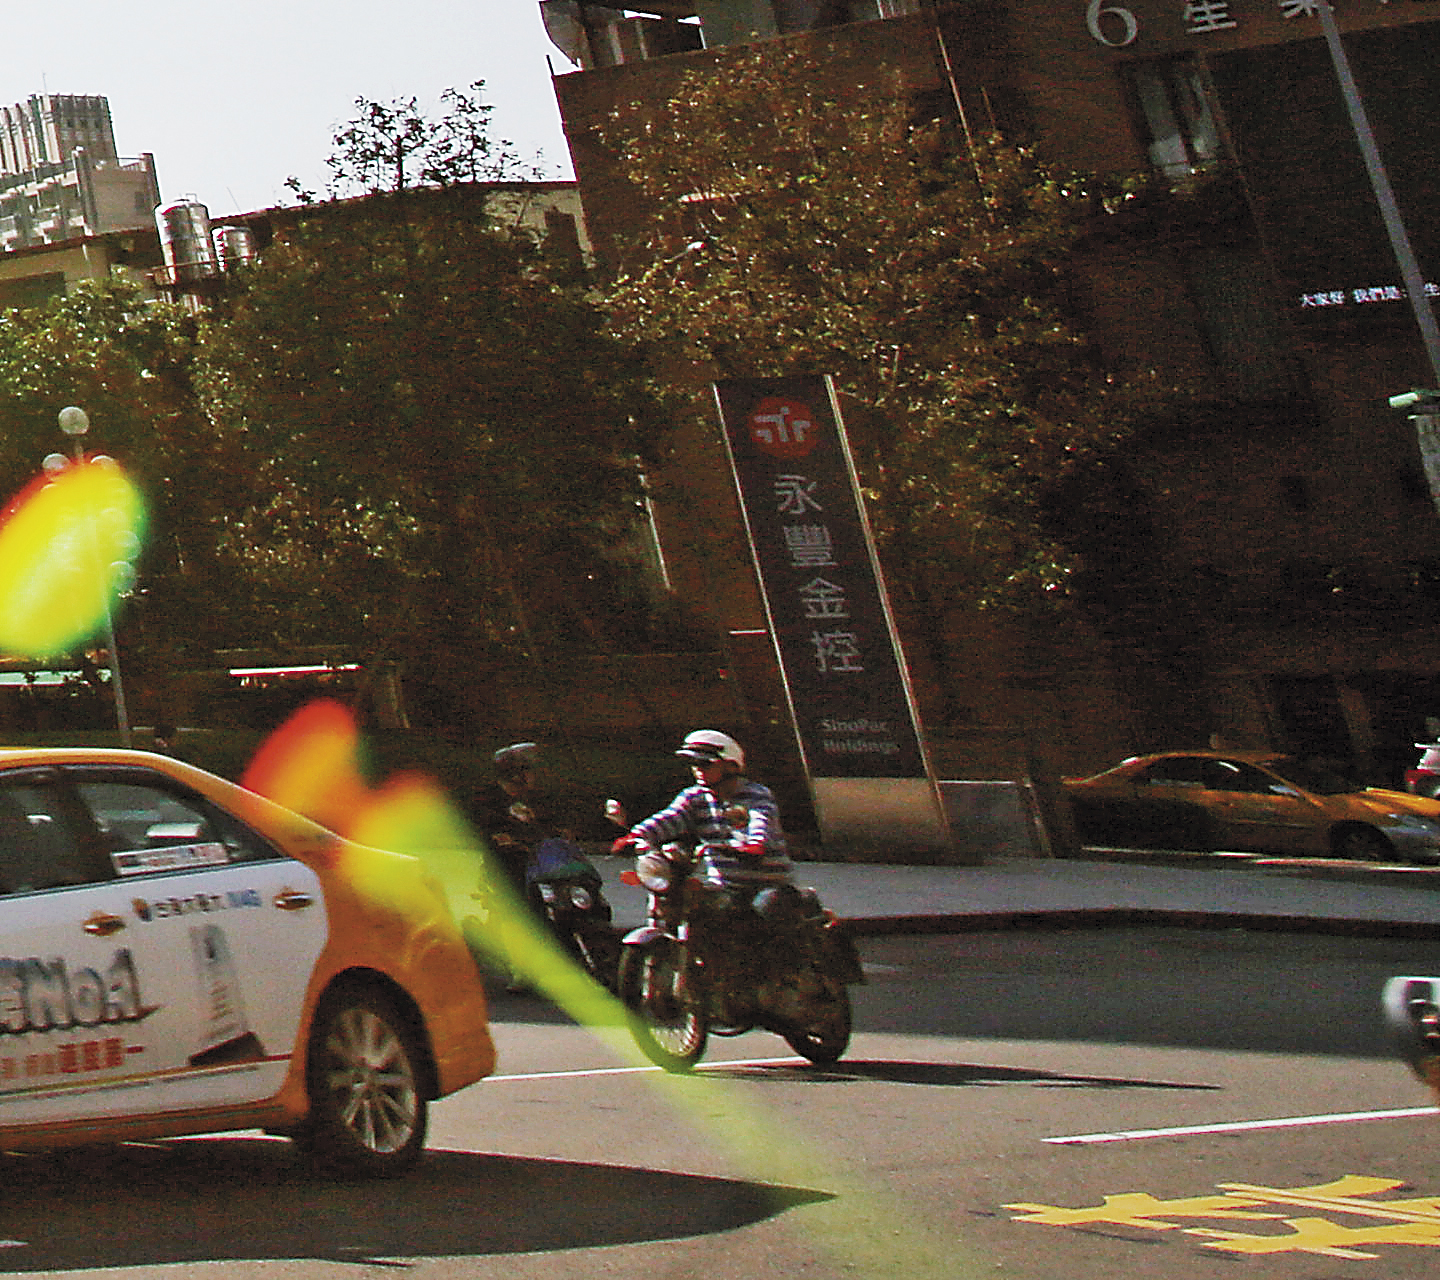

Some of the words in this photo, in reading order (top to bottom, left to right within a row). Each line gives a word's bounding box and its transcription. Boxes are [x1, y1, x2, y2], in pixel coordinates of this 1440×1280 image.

[774, 473, 865, 673] 永豐金控
[821, 718, 888, 733] SinoPac
